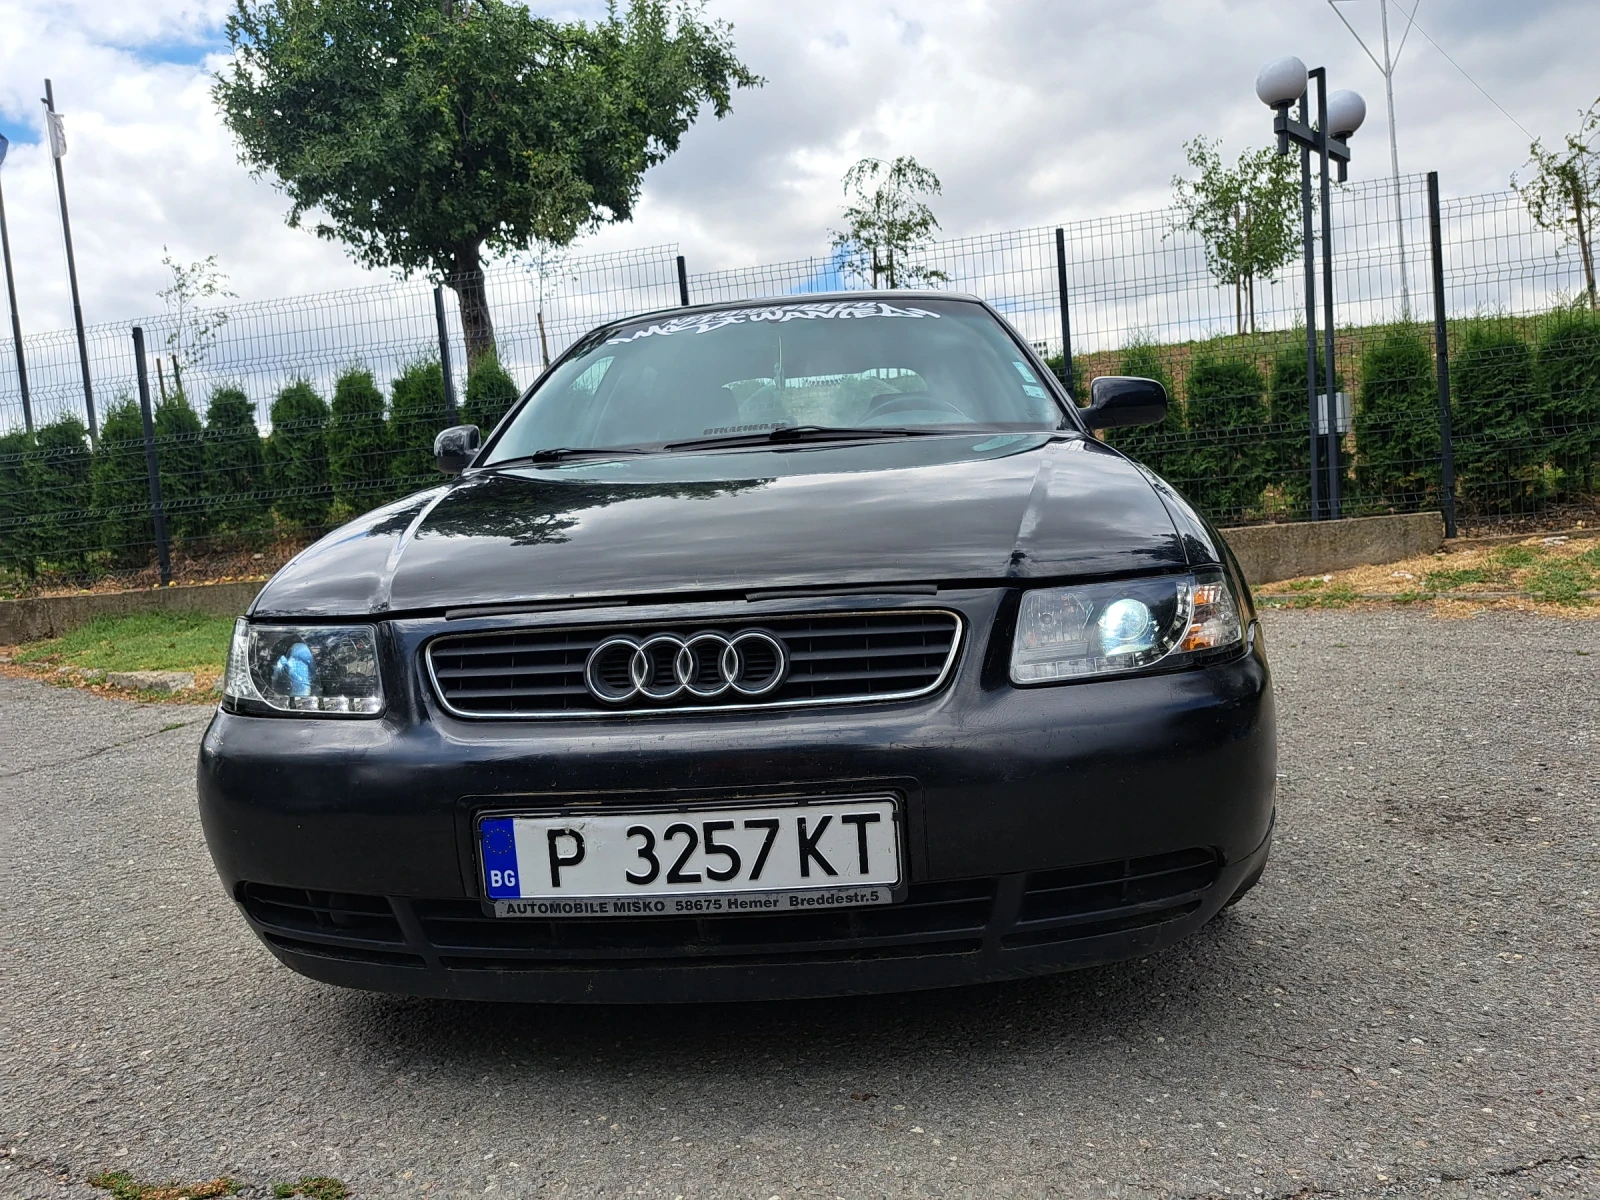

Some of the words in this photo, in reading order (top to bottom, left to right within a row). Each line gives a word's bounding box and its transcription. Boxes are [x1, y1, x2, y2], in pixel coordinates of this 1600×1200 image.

[750, 303, 942, 323] WANTED
[547, 828, 586, 888] P
[625, 818, 780, 885] 3257
[797, 813, 881, 878] KT
[490, 869, 516, 888] BG
[506, 902, 609, 914] AUTOMOBILE
[613, 900, 666, 913] MISKO
[675, 899, 722, 912] 58675
[728, 897, 779, 910] Hemer
[789, 891, 880, 907] Breddestr.5
